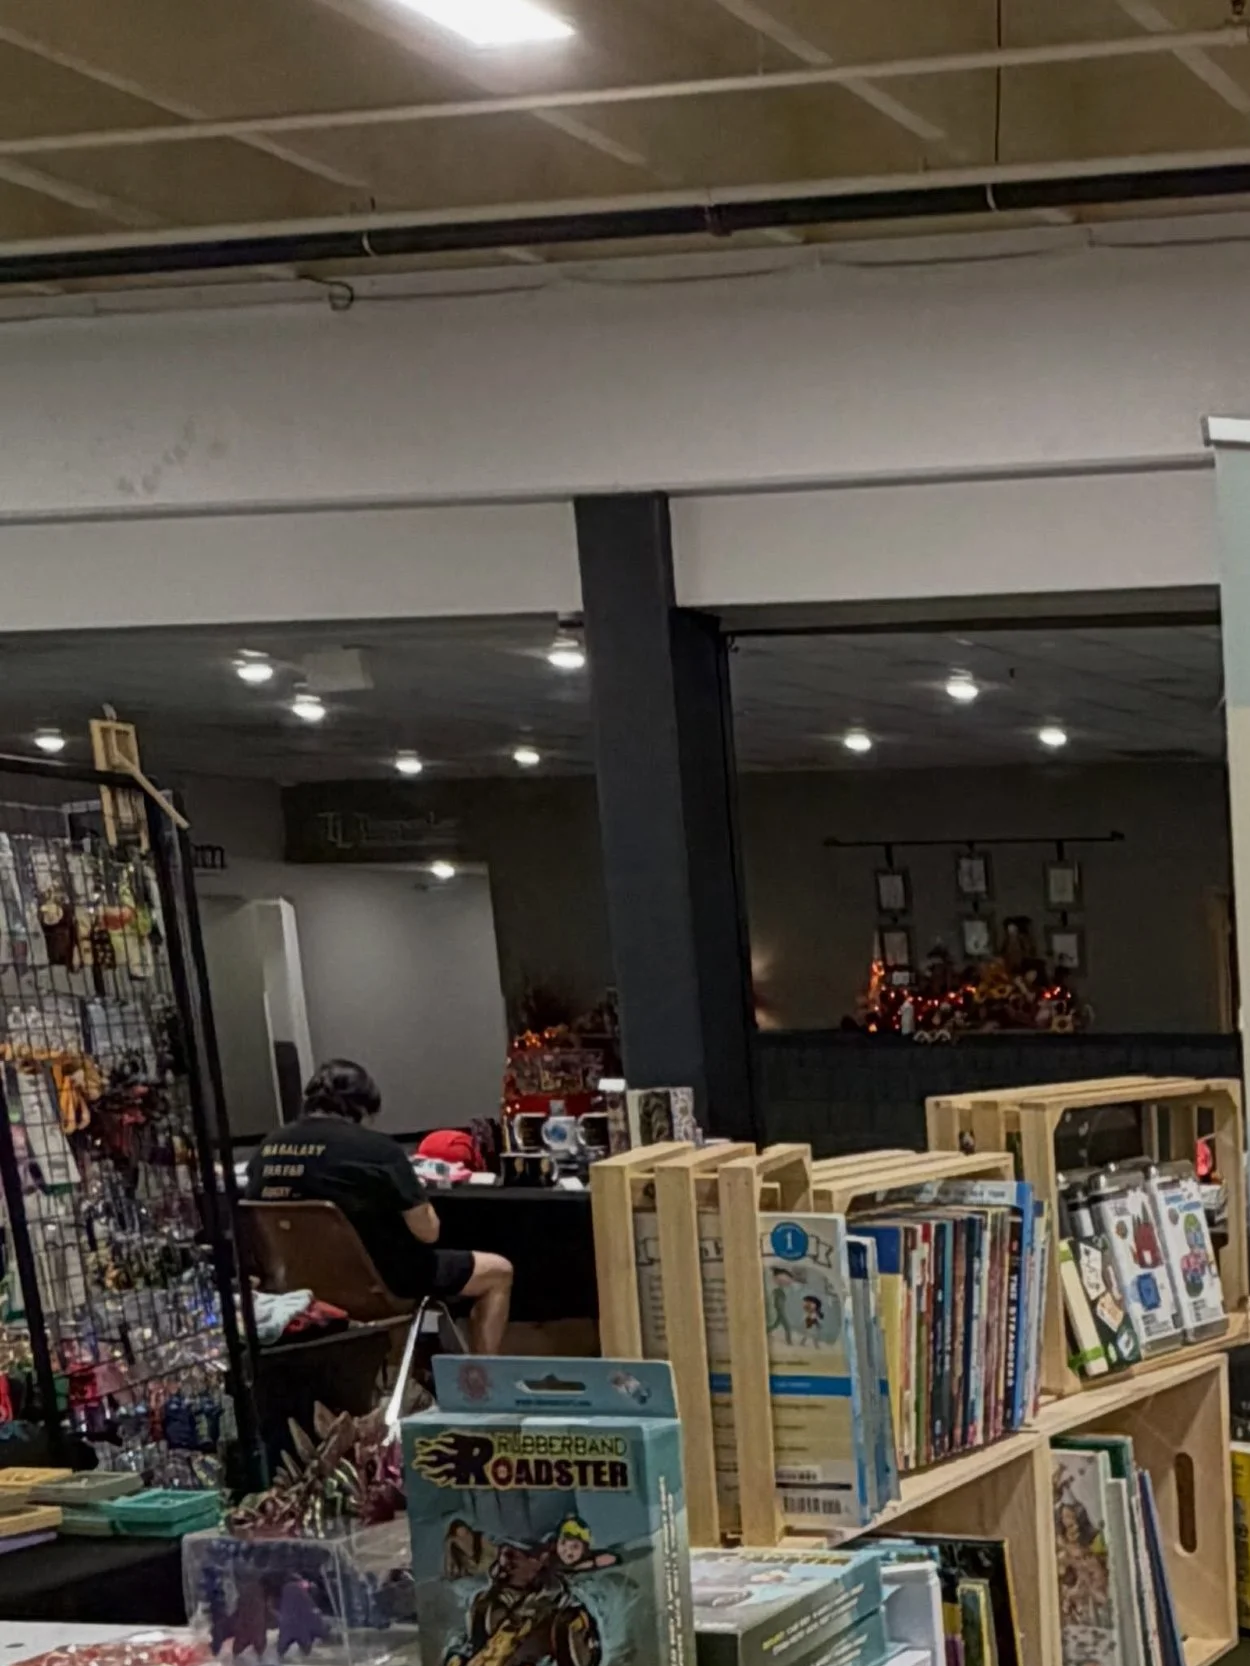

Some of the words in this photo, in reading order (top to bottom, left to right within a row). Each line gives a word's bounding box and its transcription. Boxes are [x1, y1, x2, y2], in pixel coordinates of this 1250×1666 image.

[785, 1231, 794, 1250] 1
[498, 1434, 629, 1457] RUBBERBAND
[447, 1431, 630, 1489] ROADSTER
